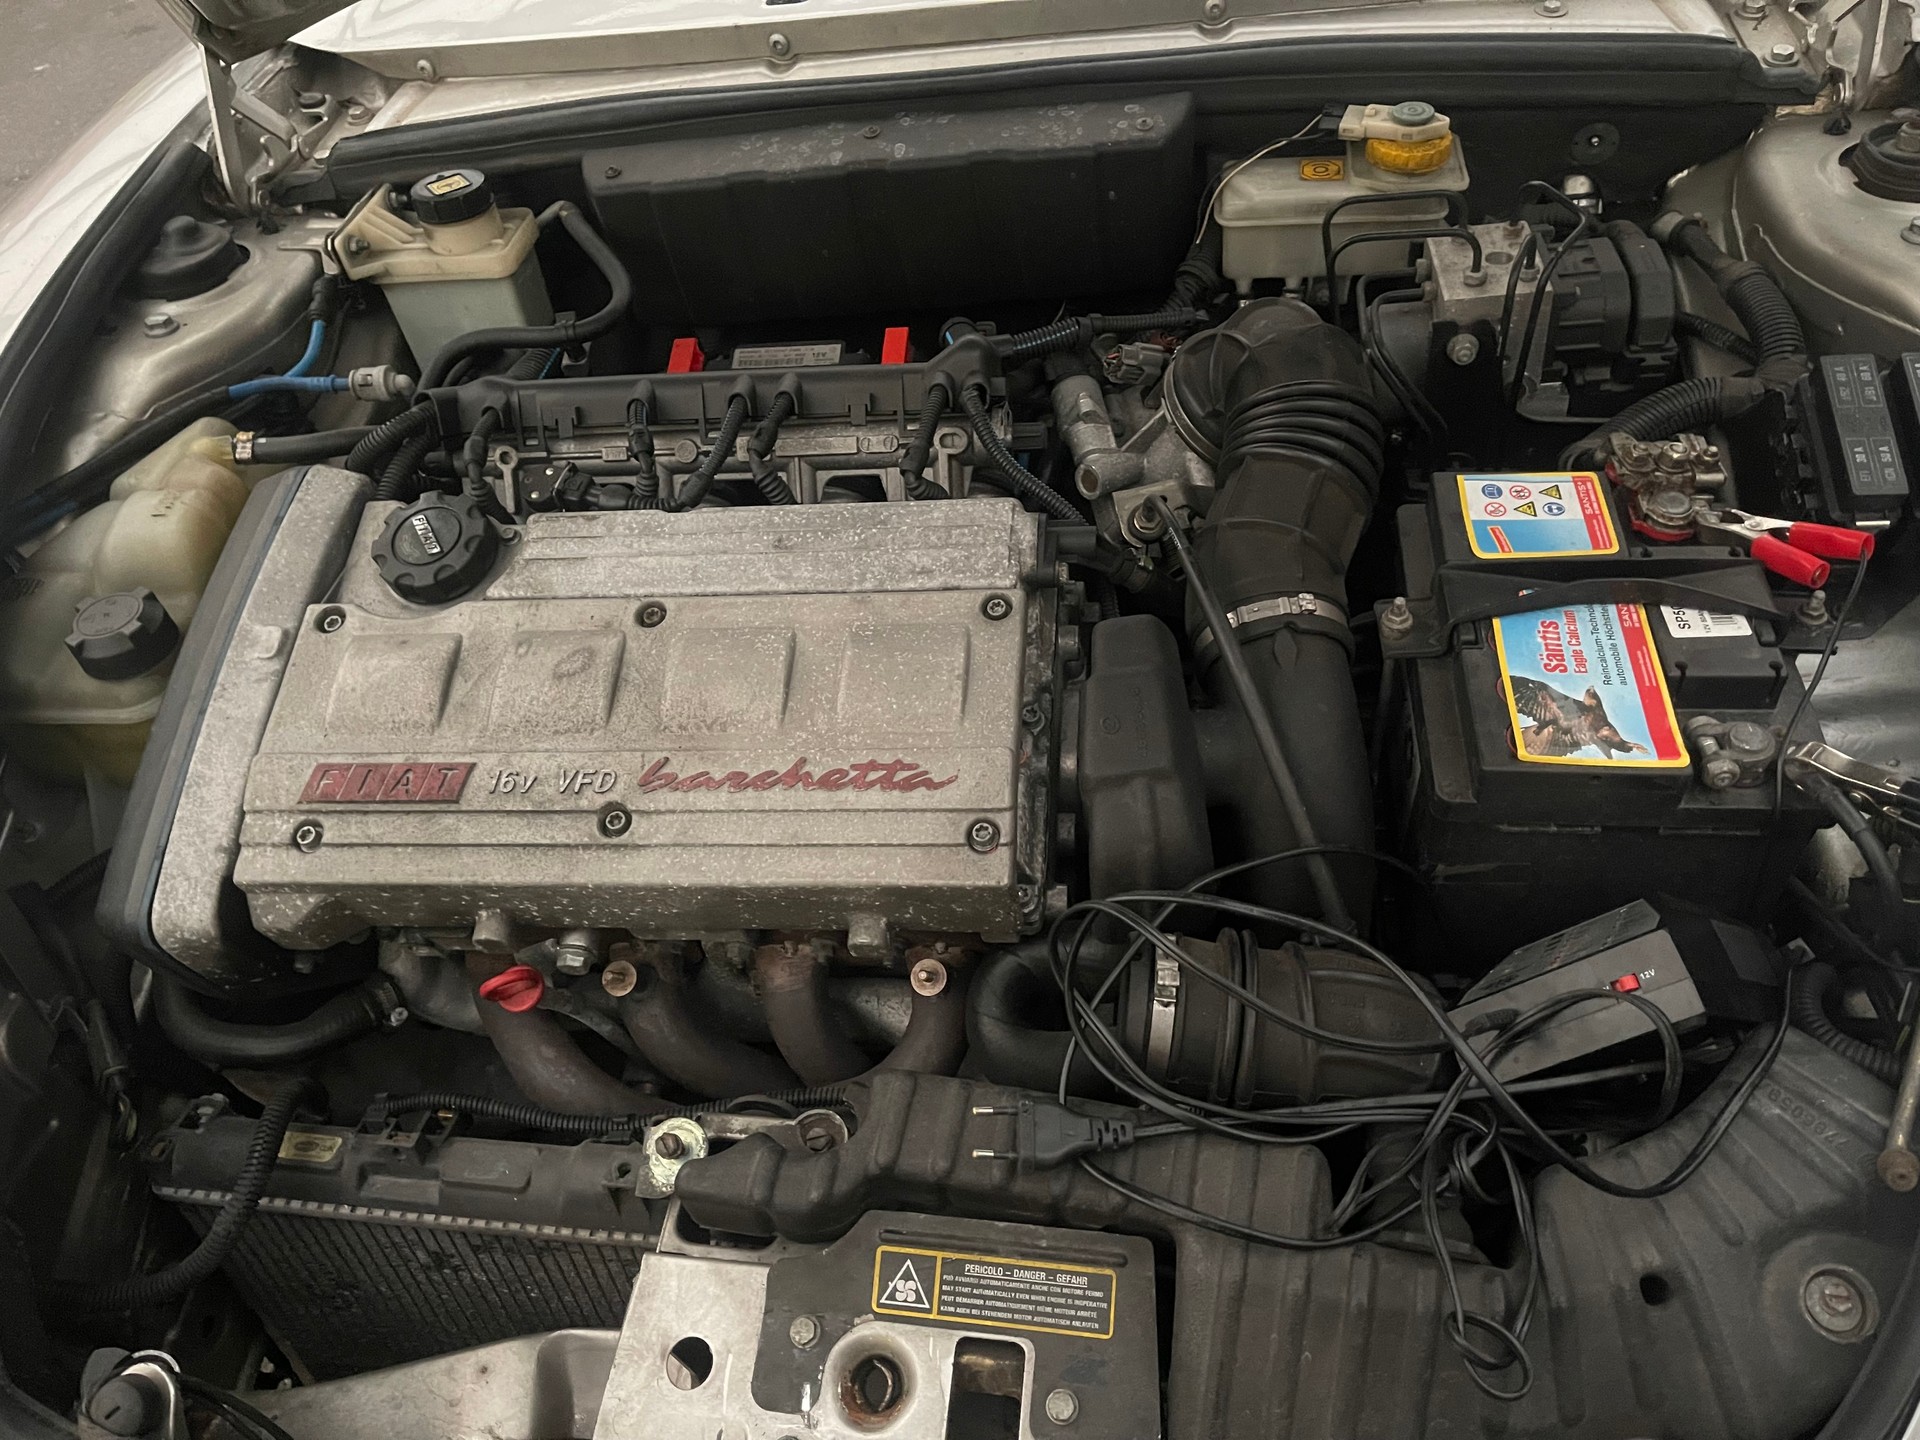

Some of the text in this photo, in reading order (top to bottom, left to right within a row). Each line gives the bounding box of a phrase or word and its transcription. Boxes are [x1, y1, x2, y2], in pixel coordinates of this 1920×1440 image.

[413, 516, 439, 552] FIAT
[1537, 620, 1569, 674] Säntis
[1563, 610, 1588, 674] Eagle Calcium
[1609, 642, 1628, 686] automobile
[310, 766, 464, 797] FIAT
[558, 768, 618, 794] VFD
[637, 756, 959, 794] barchetta
[1640, 968, 1656, 980] 12V
[965, 1264, 1003, 1276] PERICOLO
[1013, 1269, 1046, 1280] DANGER
[1056, 1273, 1088, 1284] GEFAHR
